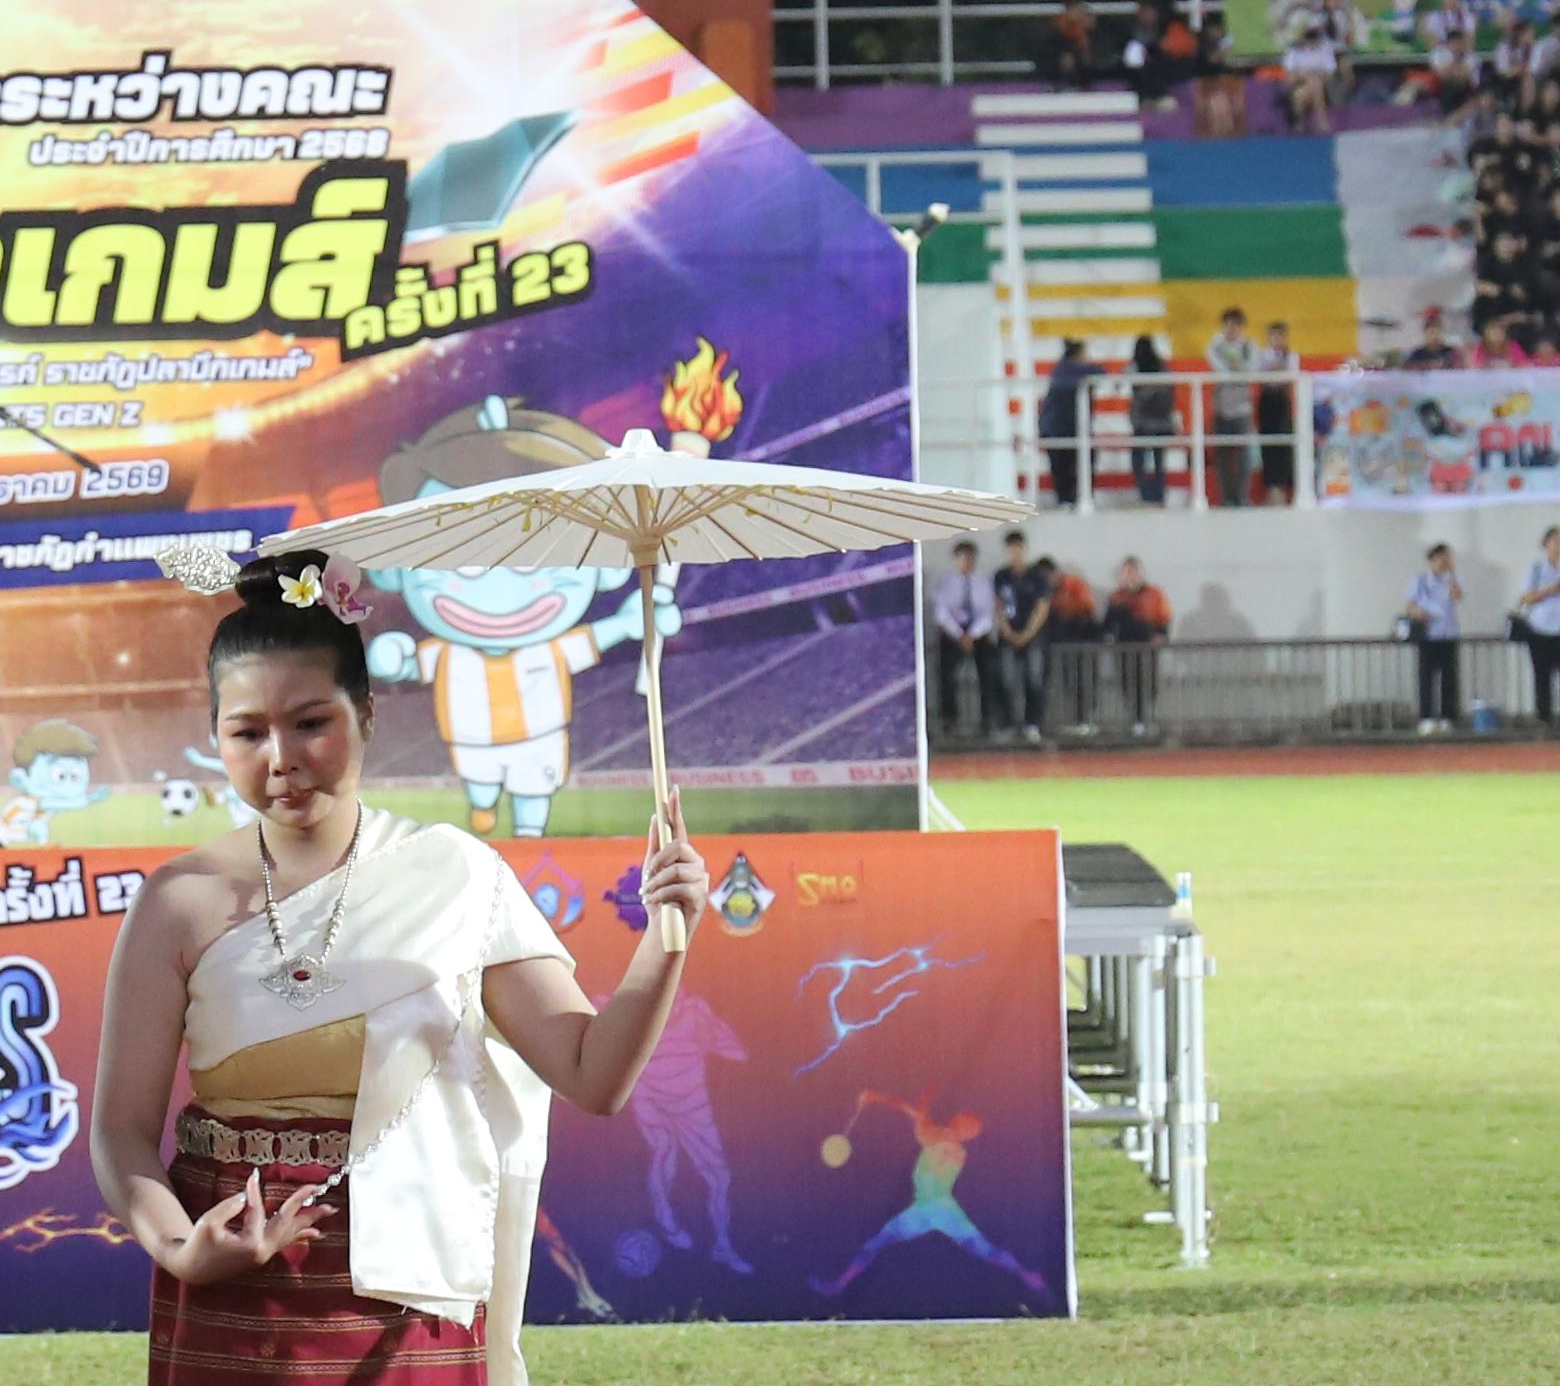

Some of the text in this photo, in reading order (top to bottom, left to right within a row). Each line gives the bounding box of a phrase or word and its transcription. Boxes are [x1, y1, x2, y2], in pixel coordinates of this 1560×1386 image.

[343, 242, 592, 354] ครั้งที่ 23
[52, 404, 116, 428] GEN
[119, 401, 143, 426] Z
[80, 459, 172, 497] 2569
